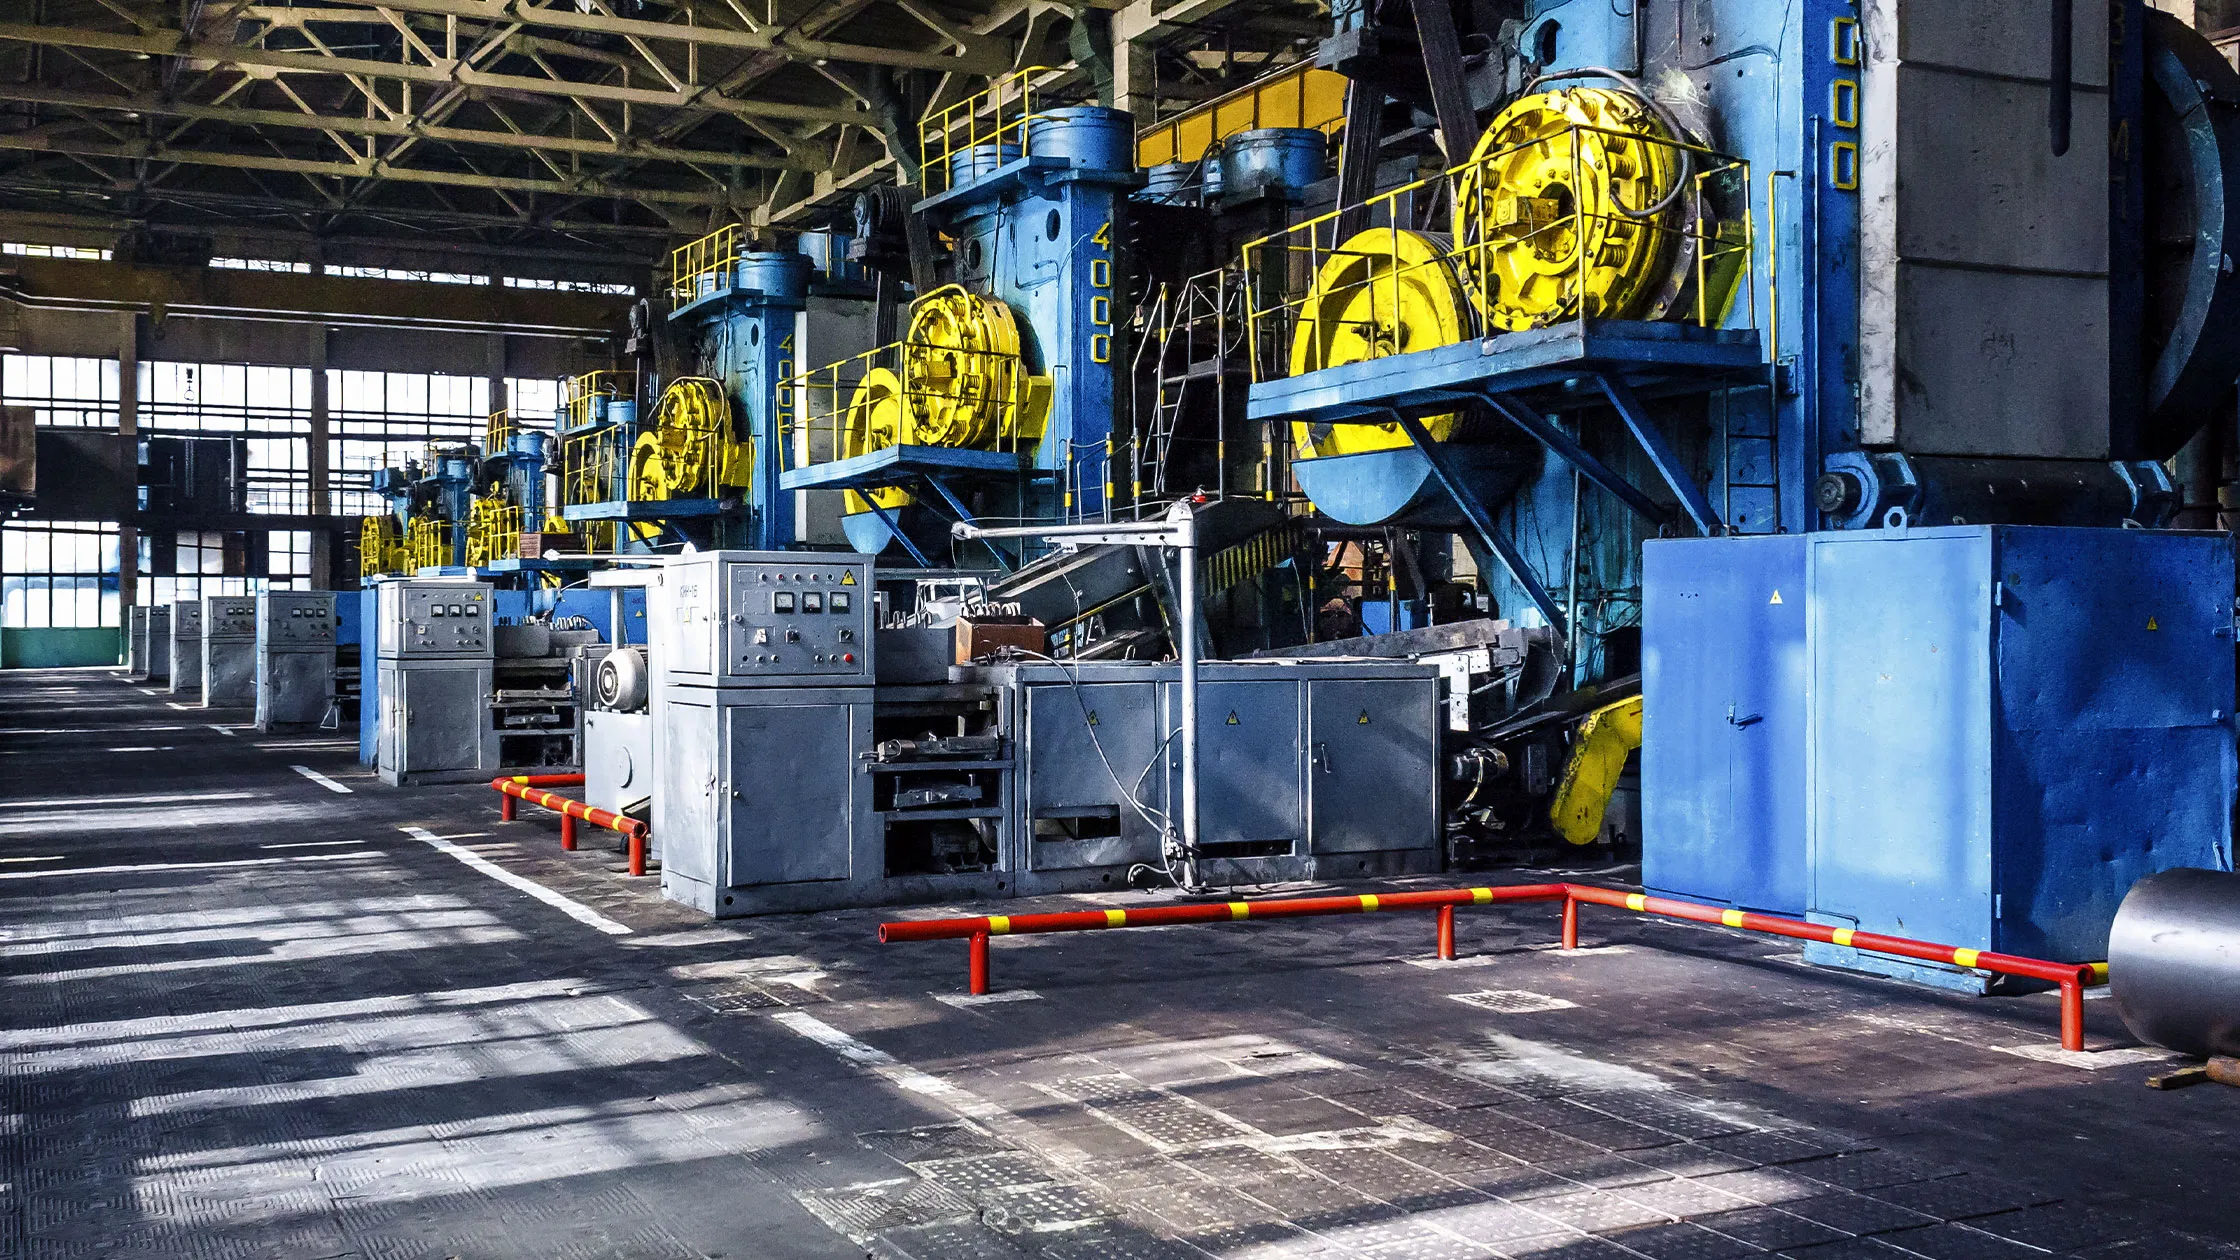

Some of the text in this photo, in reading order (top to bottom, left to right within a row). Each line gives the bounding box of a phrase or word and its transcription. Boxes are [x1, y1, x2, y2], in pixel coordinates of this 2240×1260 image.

[1832, 0, 1858, 190] 000
[1091, 222, 1110, 363] 4000
[779, 333, 793, 434] 4000
